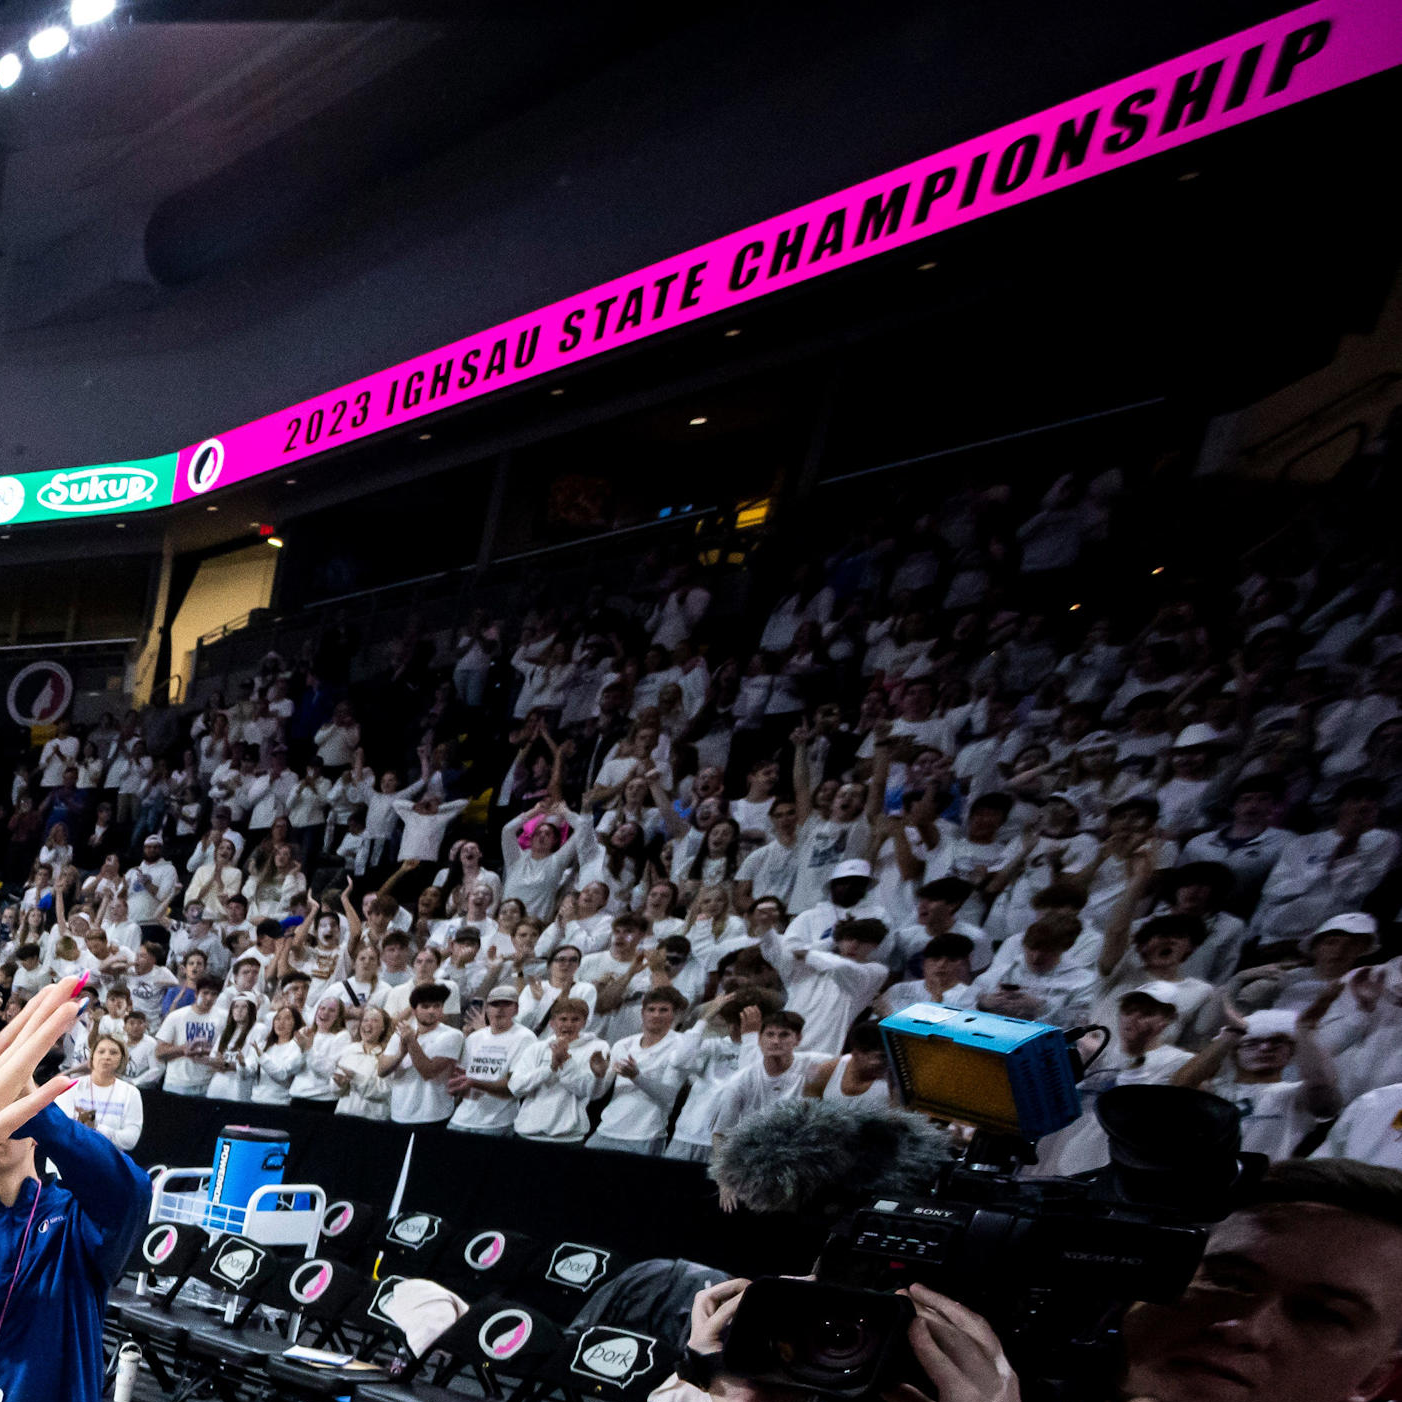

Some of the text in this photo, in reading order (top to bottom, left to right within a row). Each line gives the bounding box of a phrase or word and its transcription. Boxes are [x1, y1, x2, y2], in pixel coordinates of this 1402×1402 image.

[283, 20, 1334, 454] 2023 IGHSAU STATE CHAMPIONSHIP
[913, 1207, 955, 1219] SONY
[584, 1345, 634, 1369] pork
